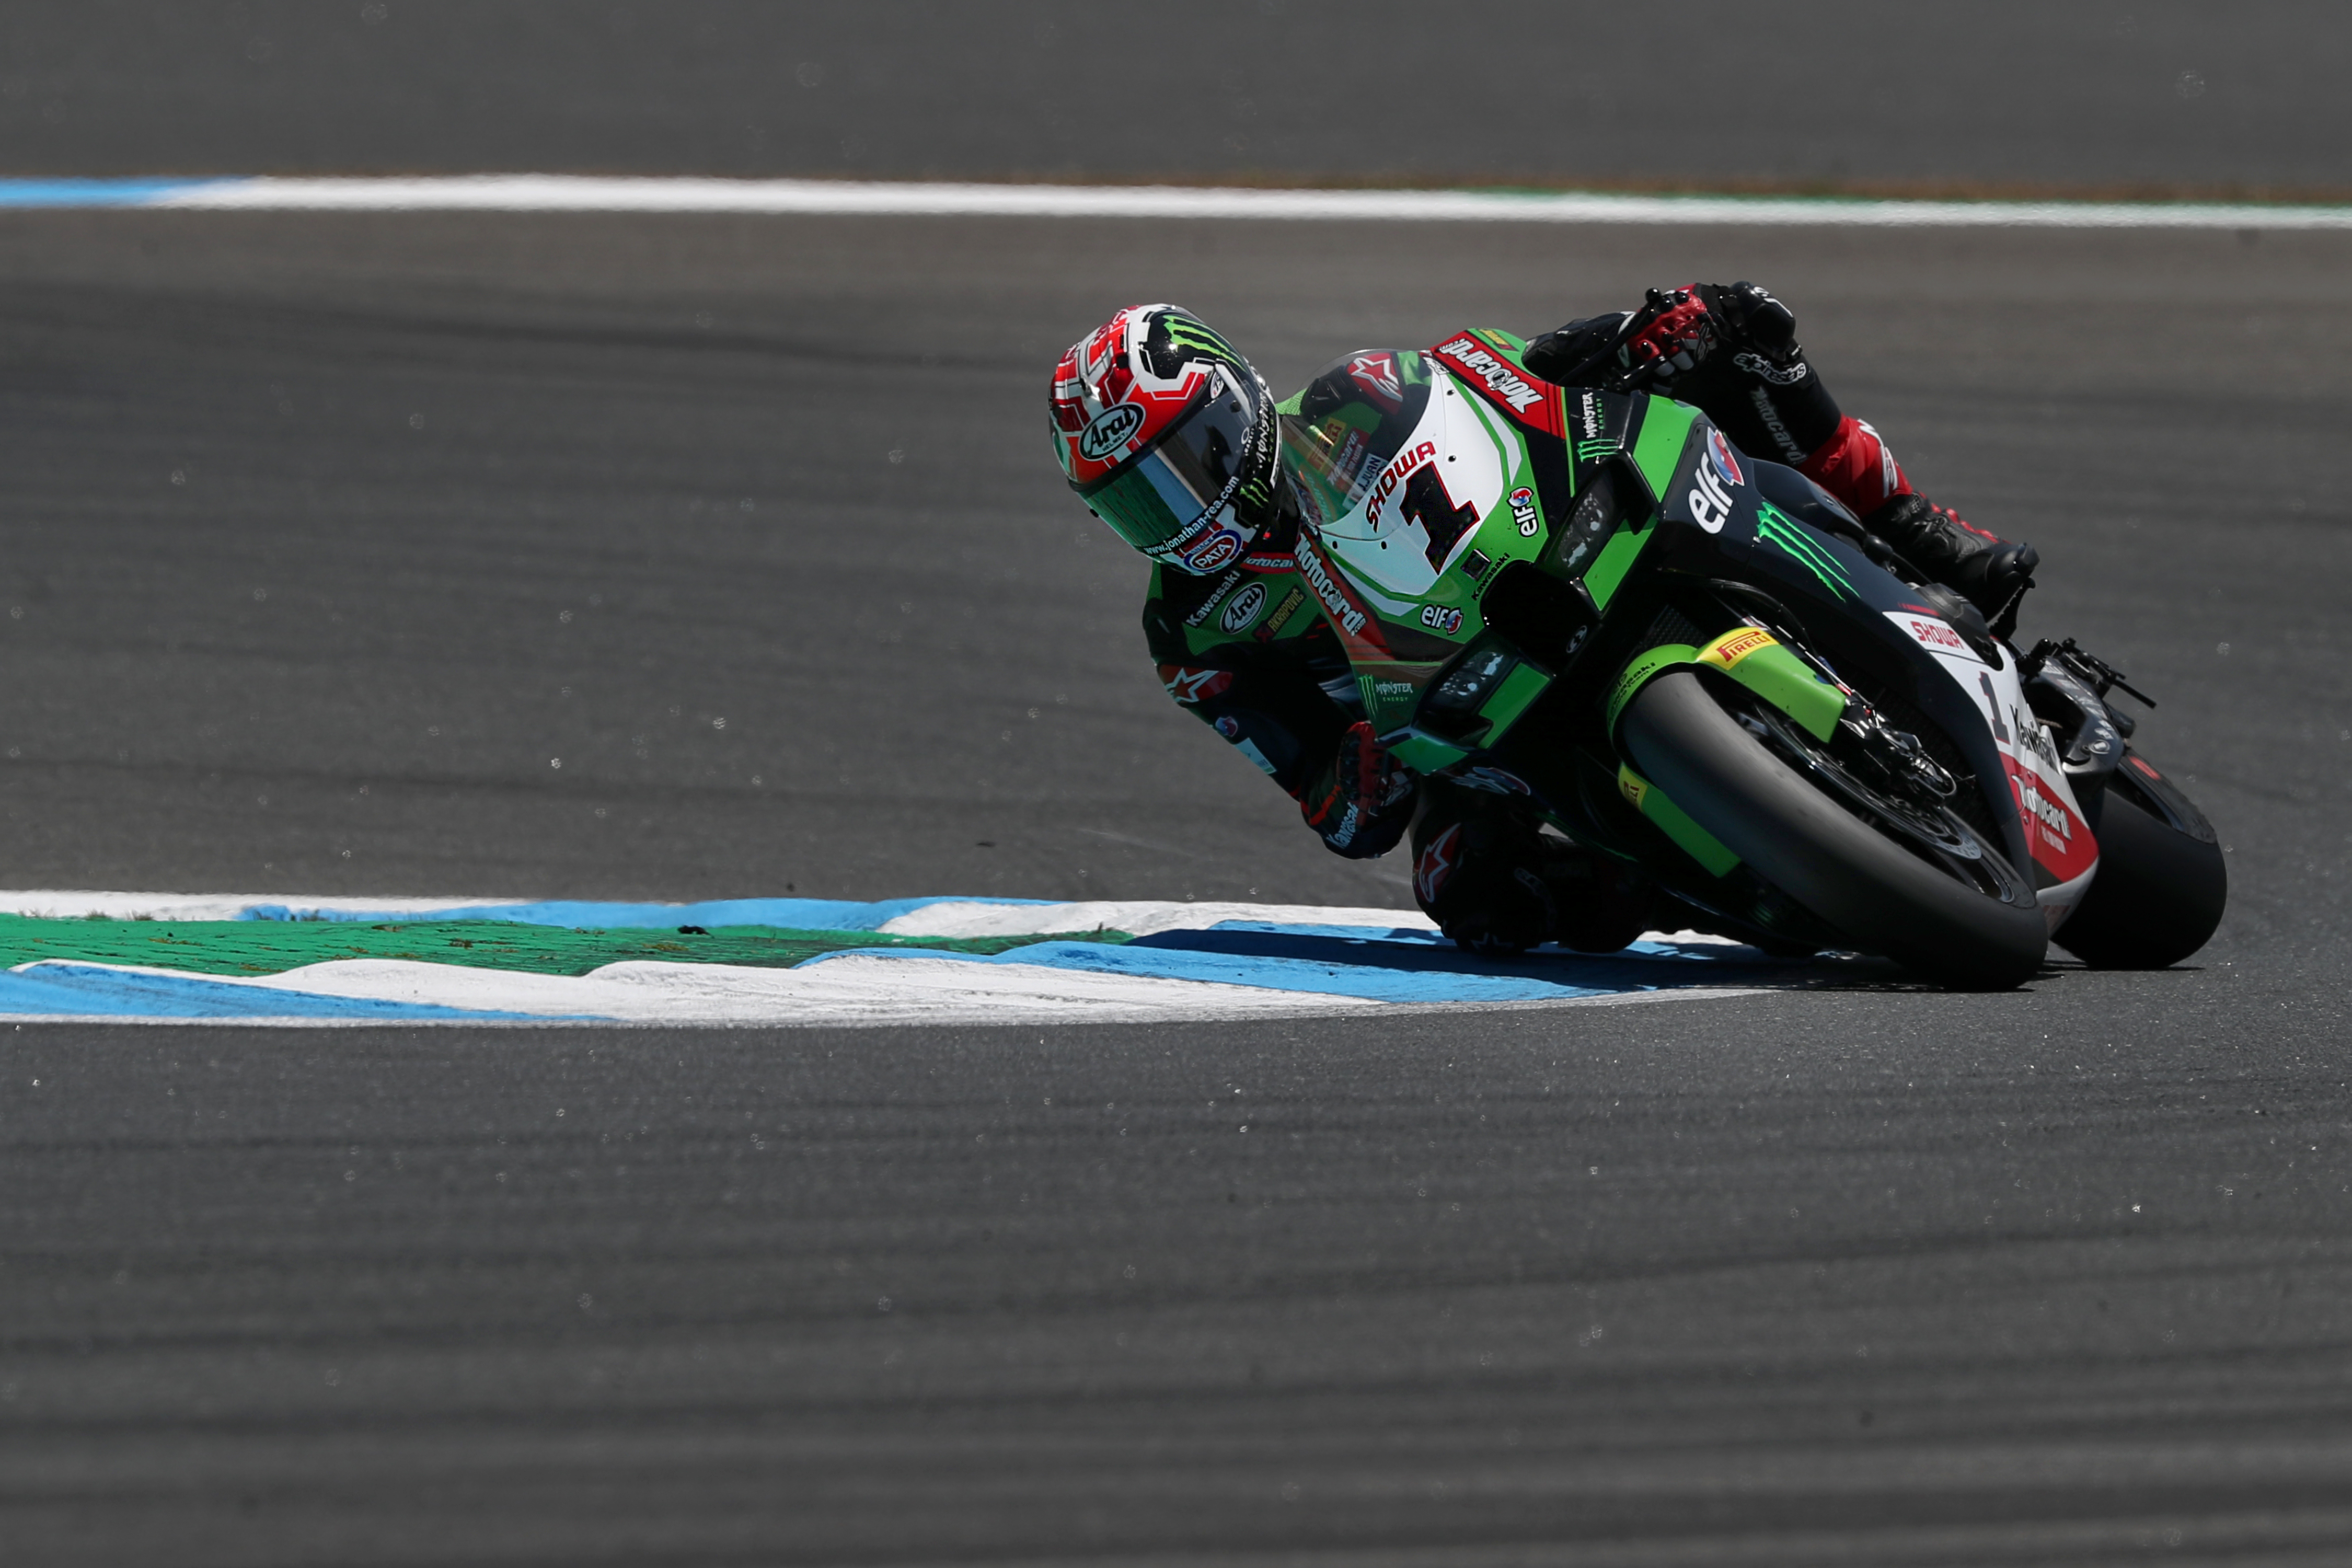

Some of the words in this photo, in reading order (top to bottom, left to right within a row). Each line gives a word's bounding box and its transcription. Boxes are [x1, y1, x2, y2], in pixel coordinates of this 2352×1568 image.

[1087, 407, 1135, 457] Arai
[1102, 432, 1126, 452] HELMET
[1365, 441, 1436, 533] SHOWA
[1688, 452, 1733, 535] elf
[1144, 476, 1240, 555] www.jonathan-rea.com
[1399, 460, 1481, 575] 1
[1515, 504, 1537, 537] elf
[1195, 544, 1232, 568] PATA
[1471, 552, 1510, 601] Kawasaki
[1186, 570, 1241, 627] Kawasaki
[1229, 586, 1261, 632] Arai
[1421, 605, 1448, 629] elf
[1716, 631, 1770, 662] PIRELLI
[1910, 621, 1964, 650] SHOWA
[1376, 681, 1413, 695] MONSTER
[1978, 671, 2011, 746] 1
[1326, 802, 1359, 849] Kawasak
